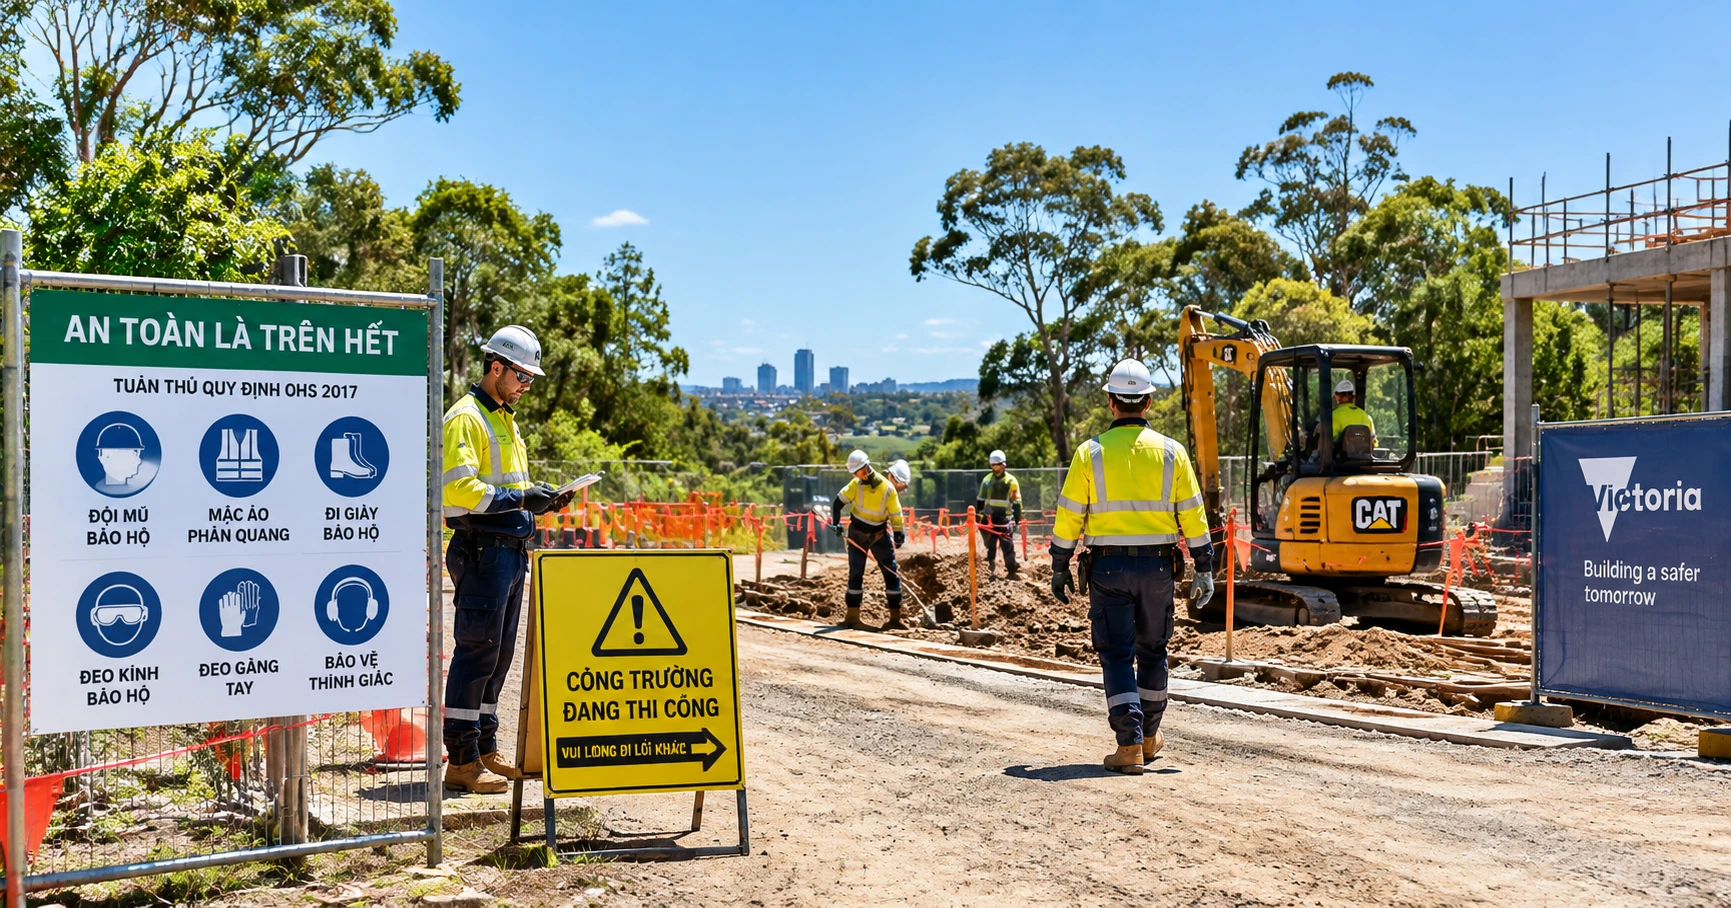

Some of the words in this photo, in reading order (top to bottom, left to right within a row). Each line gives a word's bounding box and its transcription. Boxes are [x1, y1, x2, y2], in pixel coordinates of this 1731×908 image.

[64, 315, 109, 343] AN
[120, 312, 204, 347] TOÀN
[216, 316, 251, 349] LÀ
[260, 320, 334, 352] TRÊN
[346, 320, 398, 355] HẾT
[203, 381, 236, 397] QUY
[241, 382, 279, 399] ĐỊNH
[285, 383, 317, 397] OHS
[322, 385, 357, 398] 2017
[1588, 480, 1703, 512] Victoria
[325, 508, 339, 520] ĐI
[345, 504, 378, 520] GIÀY
[1356, 499, 1401, 529] CAT
[236, 528, 289, 543] QUANG
[1585, 560, 1642, 584] Building
[1647, 567, 1655, 580] a
[1661, 563, 1700, 581] safer
[1585, 585, 1656, 605] tomorrow
[80, 669, 114, 684] ĐEO
[199, 662, 231, 676] ĐEO
[629, 665, 713, 689] TRƯỜNG
[226, 681, 253, 695] TAY
[563, 701, 619, 722] ĐANG
[626, 700, 657, 719] THI
[562, 747, 580, 758] VUI
